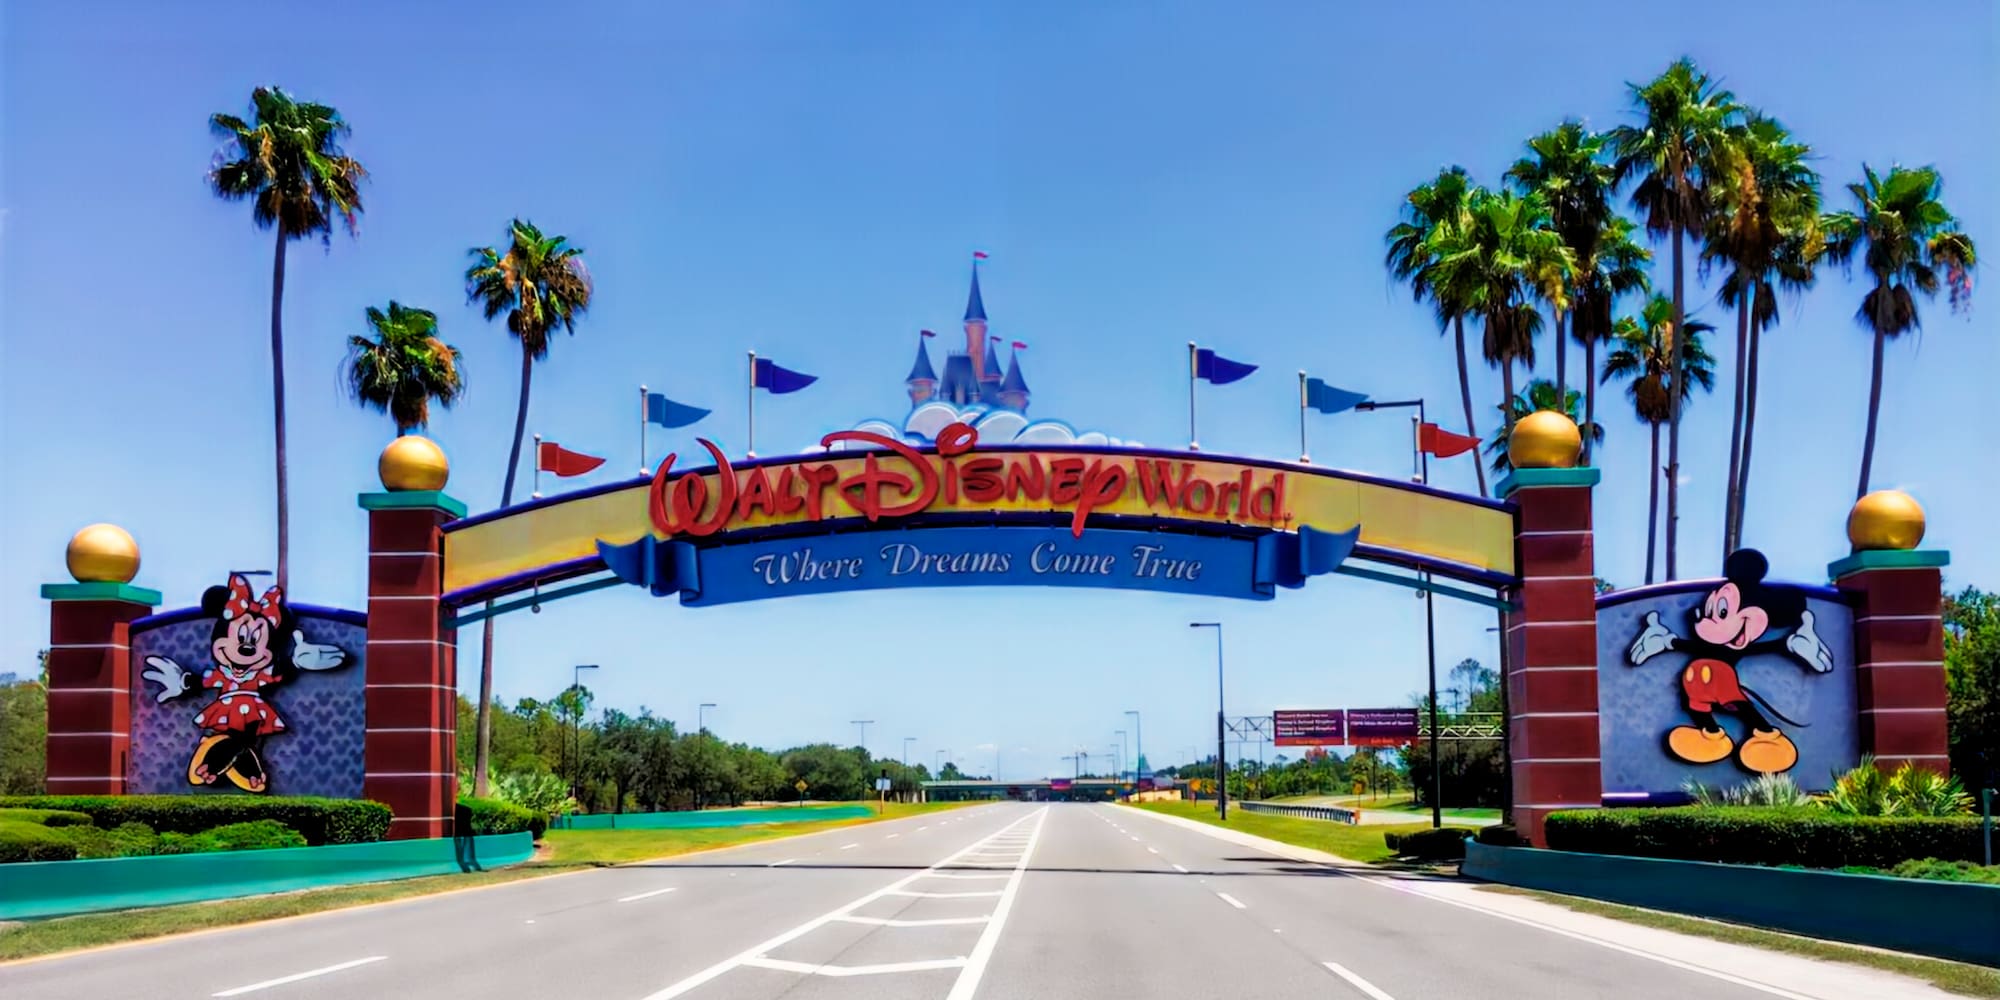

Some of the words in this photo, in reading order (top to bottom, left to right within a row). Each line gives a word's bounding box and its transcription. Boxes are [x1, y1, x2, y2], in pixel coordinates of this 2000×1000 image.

[752, 548, 863, 585] Where
[880, 542, 1012, 576] Dreams
[1030, 541, 1116, 575] Come
[1132, 545, 1203, 582] True
